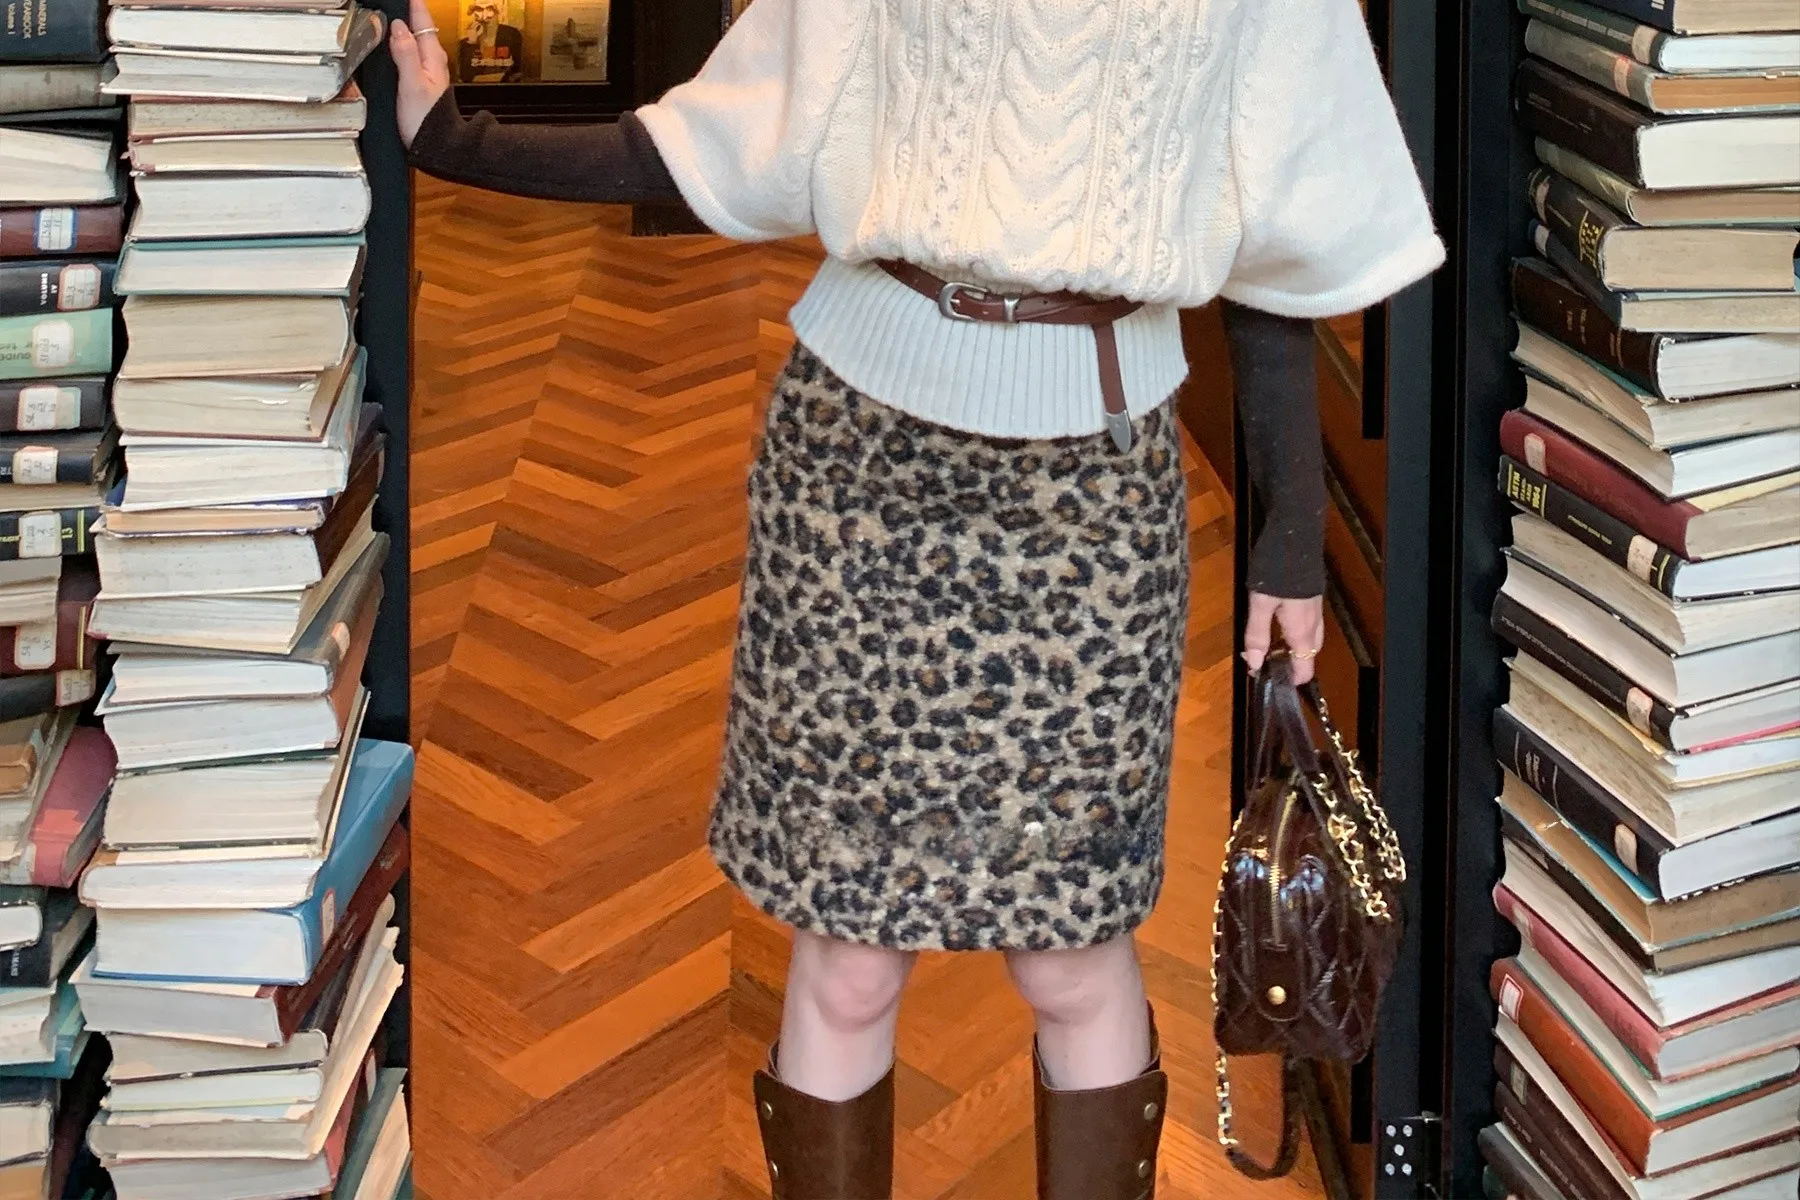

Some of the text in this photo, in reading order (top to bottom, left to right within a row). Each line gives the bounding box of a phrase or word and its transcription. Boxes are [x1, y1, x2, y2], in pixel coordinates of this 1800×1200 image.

[7, 2, 16, 29] Volume
[37, 0, 47, 36] MINERALS
[39, 272, 49, 306] VOLUME
[1512, 471, 1521, 499] ASTM
[61, 527, 74, 539] 13
